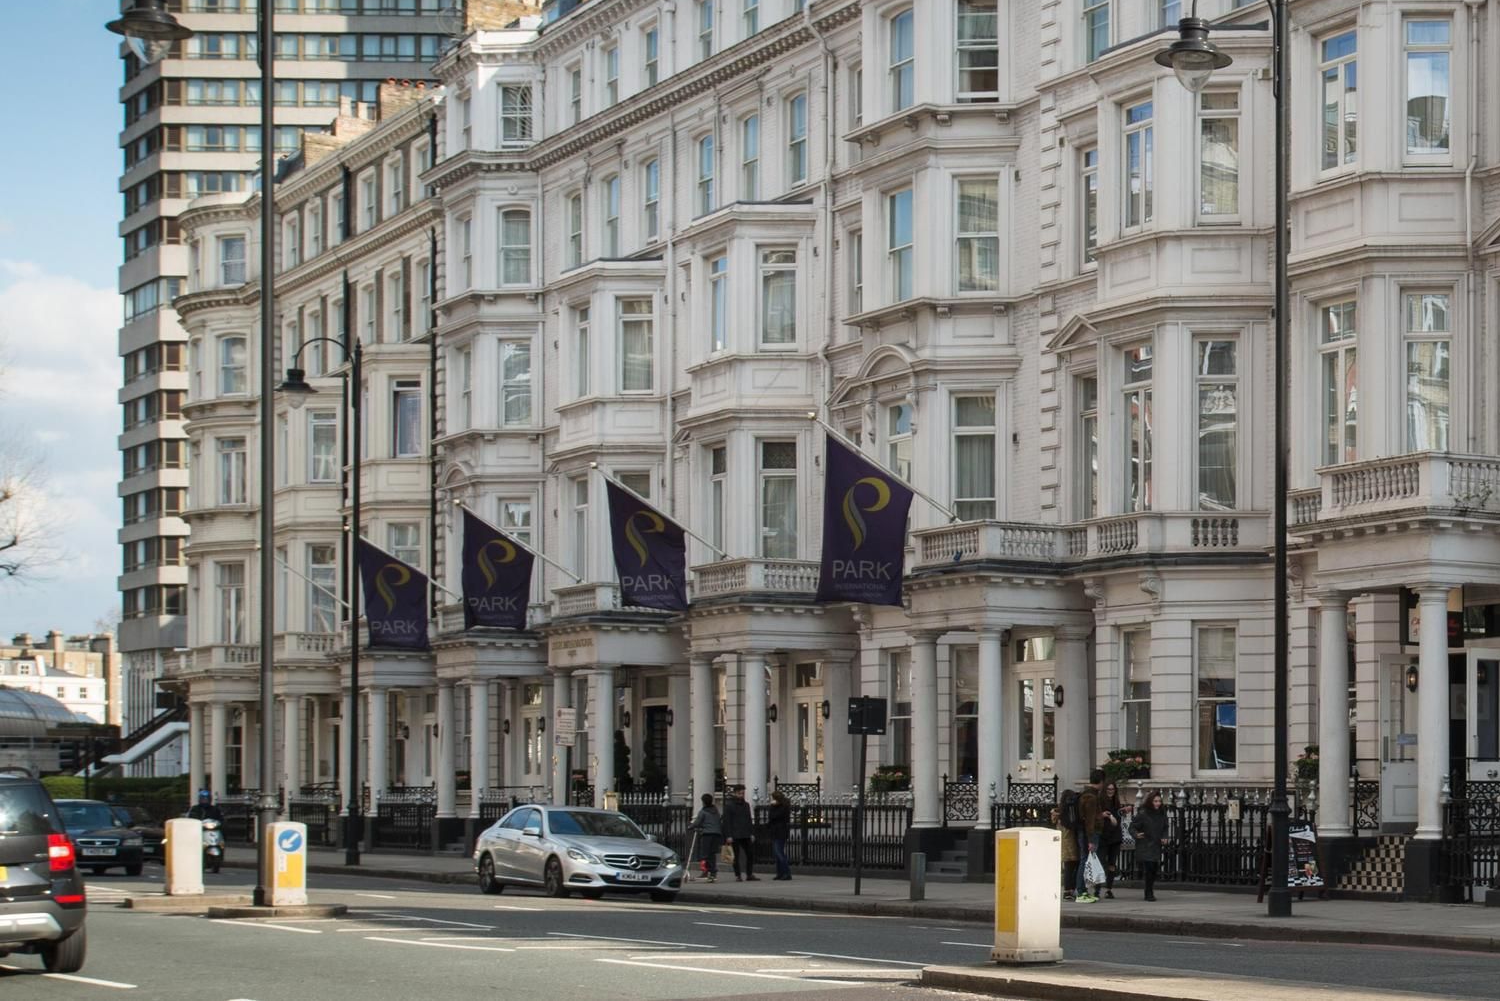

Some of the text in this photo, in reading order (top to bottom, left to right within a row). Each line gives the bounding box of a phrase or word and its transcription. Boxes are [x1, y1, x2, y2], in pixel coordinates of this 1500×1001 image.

[832, 560, 892, 580] PARK
[621, 574, 677, 592] PARK
[468, 596, 518, 612] PARK
[371, 619, 419, 634] PARK
